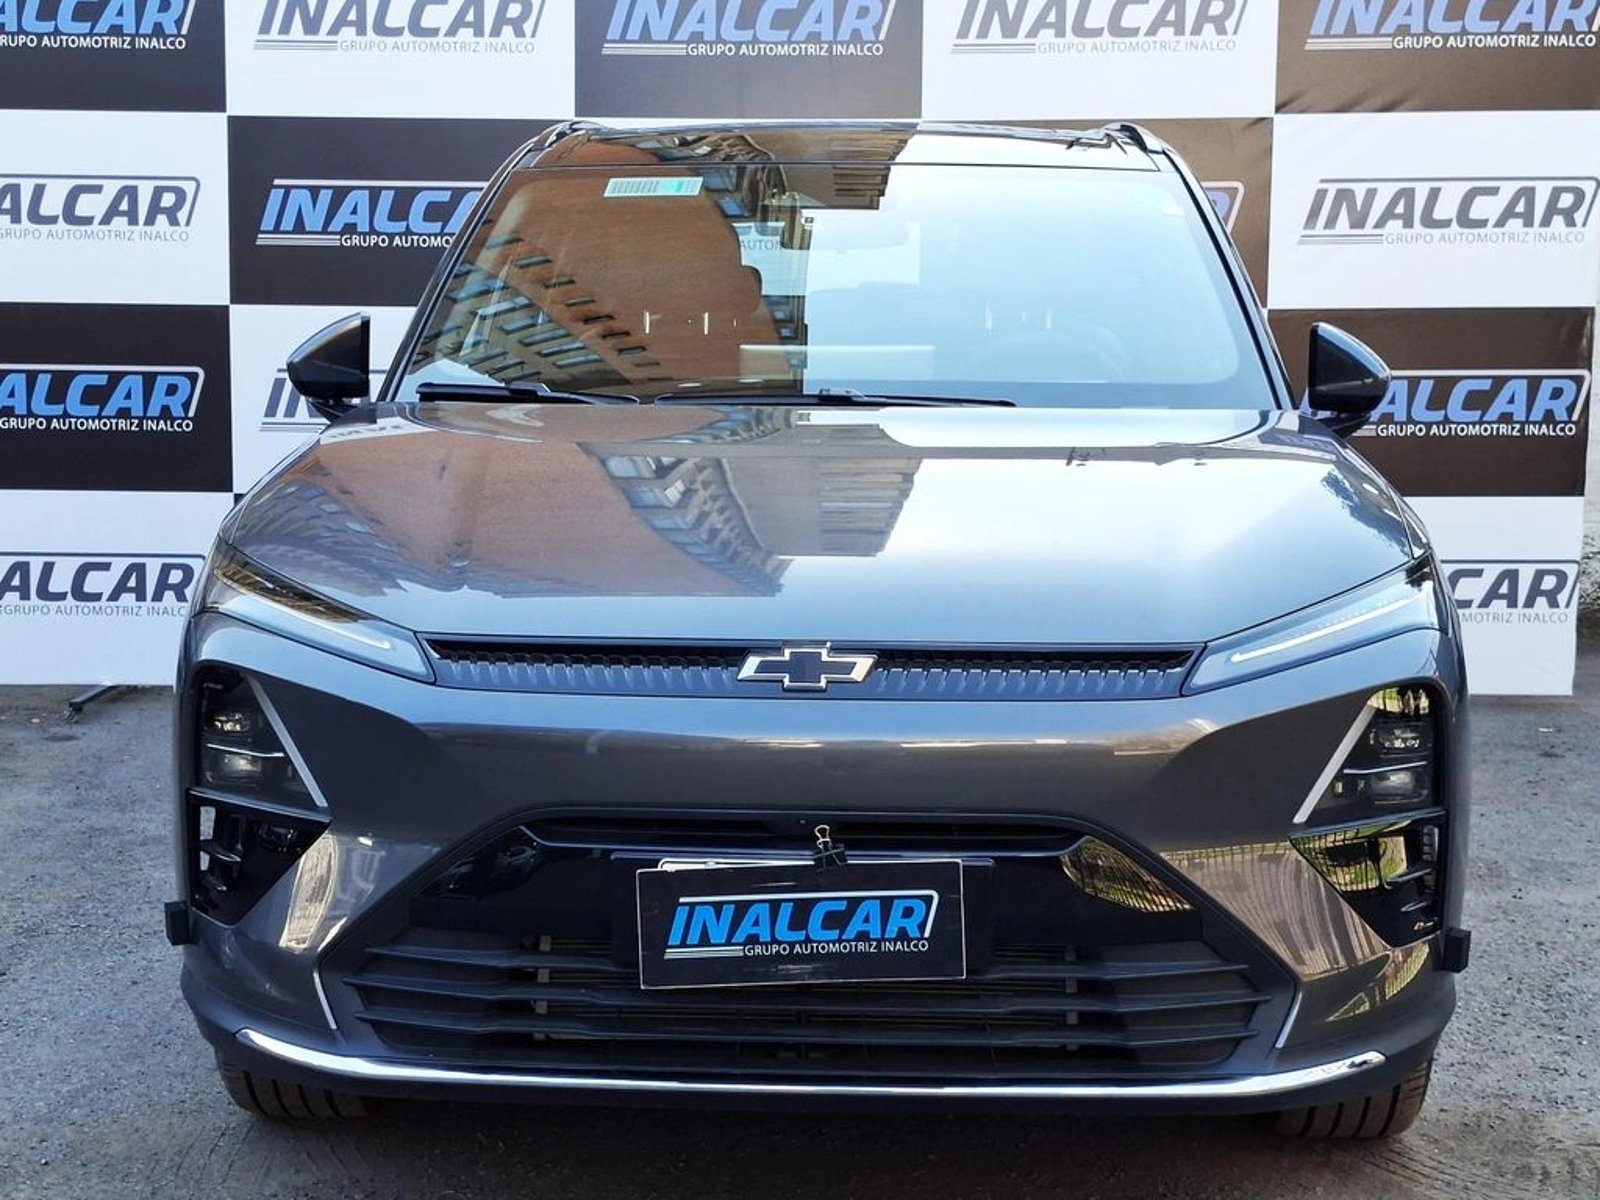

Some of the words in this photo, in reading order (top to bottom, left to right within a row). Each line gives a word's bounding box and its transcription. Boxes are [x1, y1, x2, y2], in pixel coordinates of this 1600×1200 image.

[257, 0, 534, 38] INALCAR
[605, 0, 885, 41] INALCAR
[955, 0, 1236, 39] INALCAR
[1310, 0, 1592, 35] INALCAR
[42, 36, 131, 49] AUTOMOTRIZ
[135, 37, 187, 50] INALCO
[340, 40, 387, 52] GRUPO
[391, 40, 480, 53] AUTOMOTRIZ
[484, 41, 535, 53] INALCO
[1037, 42, 1086, 54] GRUPO
[1090, 40, 1181, 53] AUTOMOTRIZ
[1184, 39, 1237, 51] INALCO
[1393, 36, 1443, 49] GRUPO
[1446, 35, 1539, 48] AUTOMOTRIZ
[1543, 34, 1596, 47] INALCO
[688, 43, 735, 56] GRUPO
[739, 43, 829, 56] AUTOMOTRIZ
[833, 43, 884, 56] INALCO
[0, 183, 188, 227] ALCAR
[1302, 186, 1587, 230] INALCAR
[46, 228, 135, 241] AUTOMOTRIZ
[139, 230, 190, 242] INALCO
[341, 235, 388, 247] GRUPO
[392, 235, 454, 248] AUTOMO
[1385, 232, 1434, 245] GRUPO
[1438, 231, 1529, 244] AUTOMOTRIZ
[1533, 231, 1585, 244] INALCO
[0, 373, 192, 417] ALCAR
[1300, 379, 1577, 422] ALCAR
[0, 417, 46, 430] GRUPO
[50, 418, 139, 431] AUTOMOTRIZ
[143, 419, 193, 432] INALCO
[1377, 424, 1426, 436] GRUPO
[1429, 424, 1520, 436] AUTOMOTRIZ
[1524, 424, 1576, 436] INALCO
[0, 561, 195, 602] ALCAR
[3, 604, 50, 615] GRUPO
[55, 605, 143, 617] AUTOMOTRIZ
[1517, 612, 1568, 624] INALCO
[667, 899, 927, 946] INALCAR
[744, 944, 790, 956] GRUPO
[793, 941, 878, 954] AUTOMOTRIZ
[881, 940, 929, 952] INALCO
